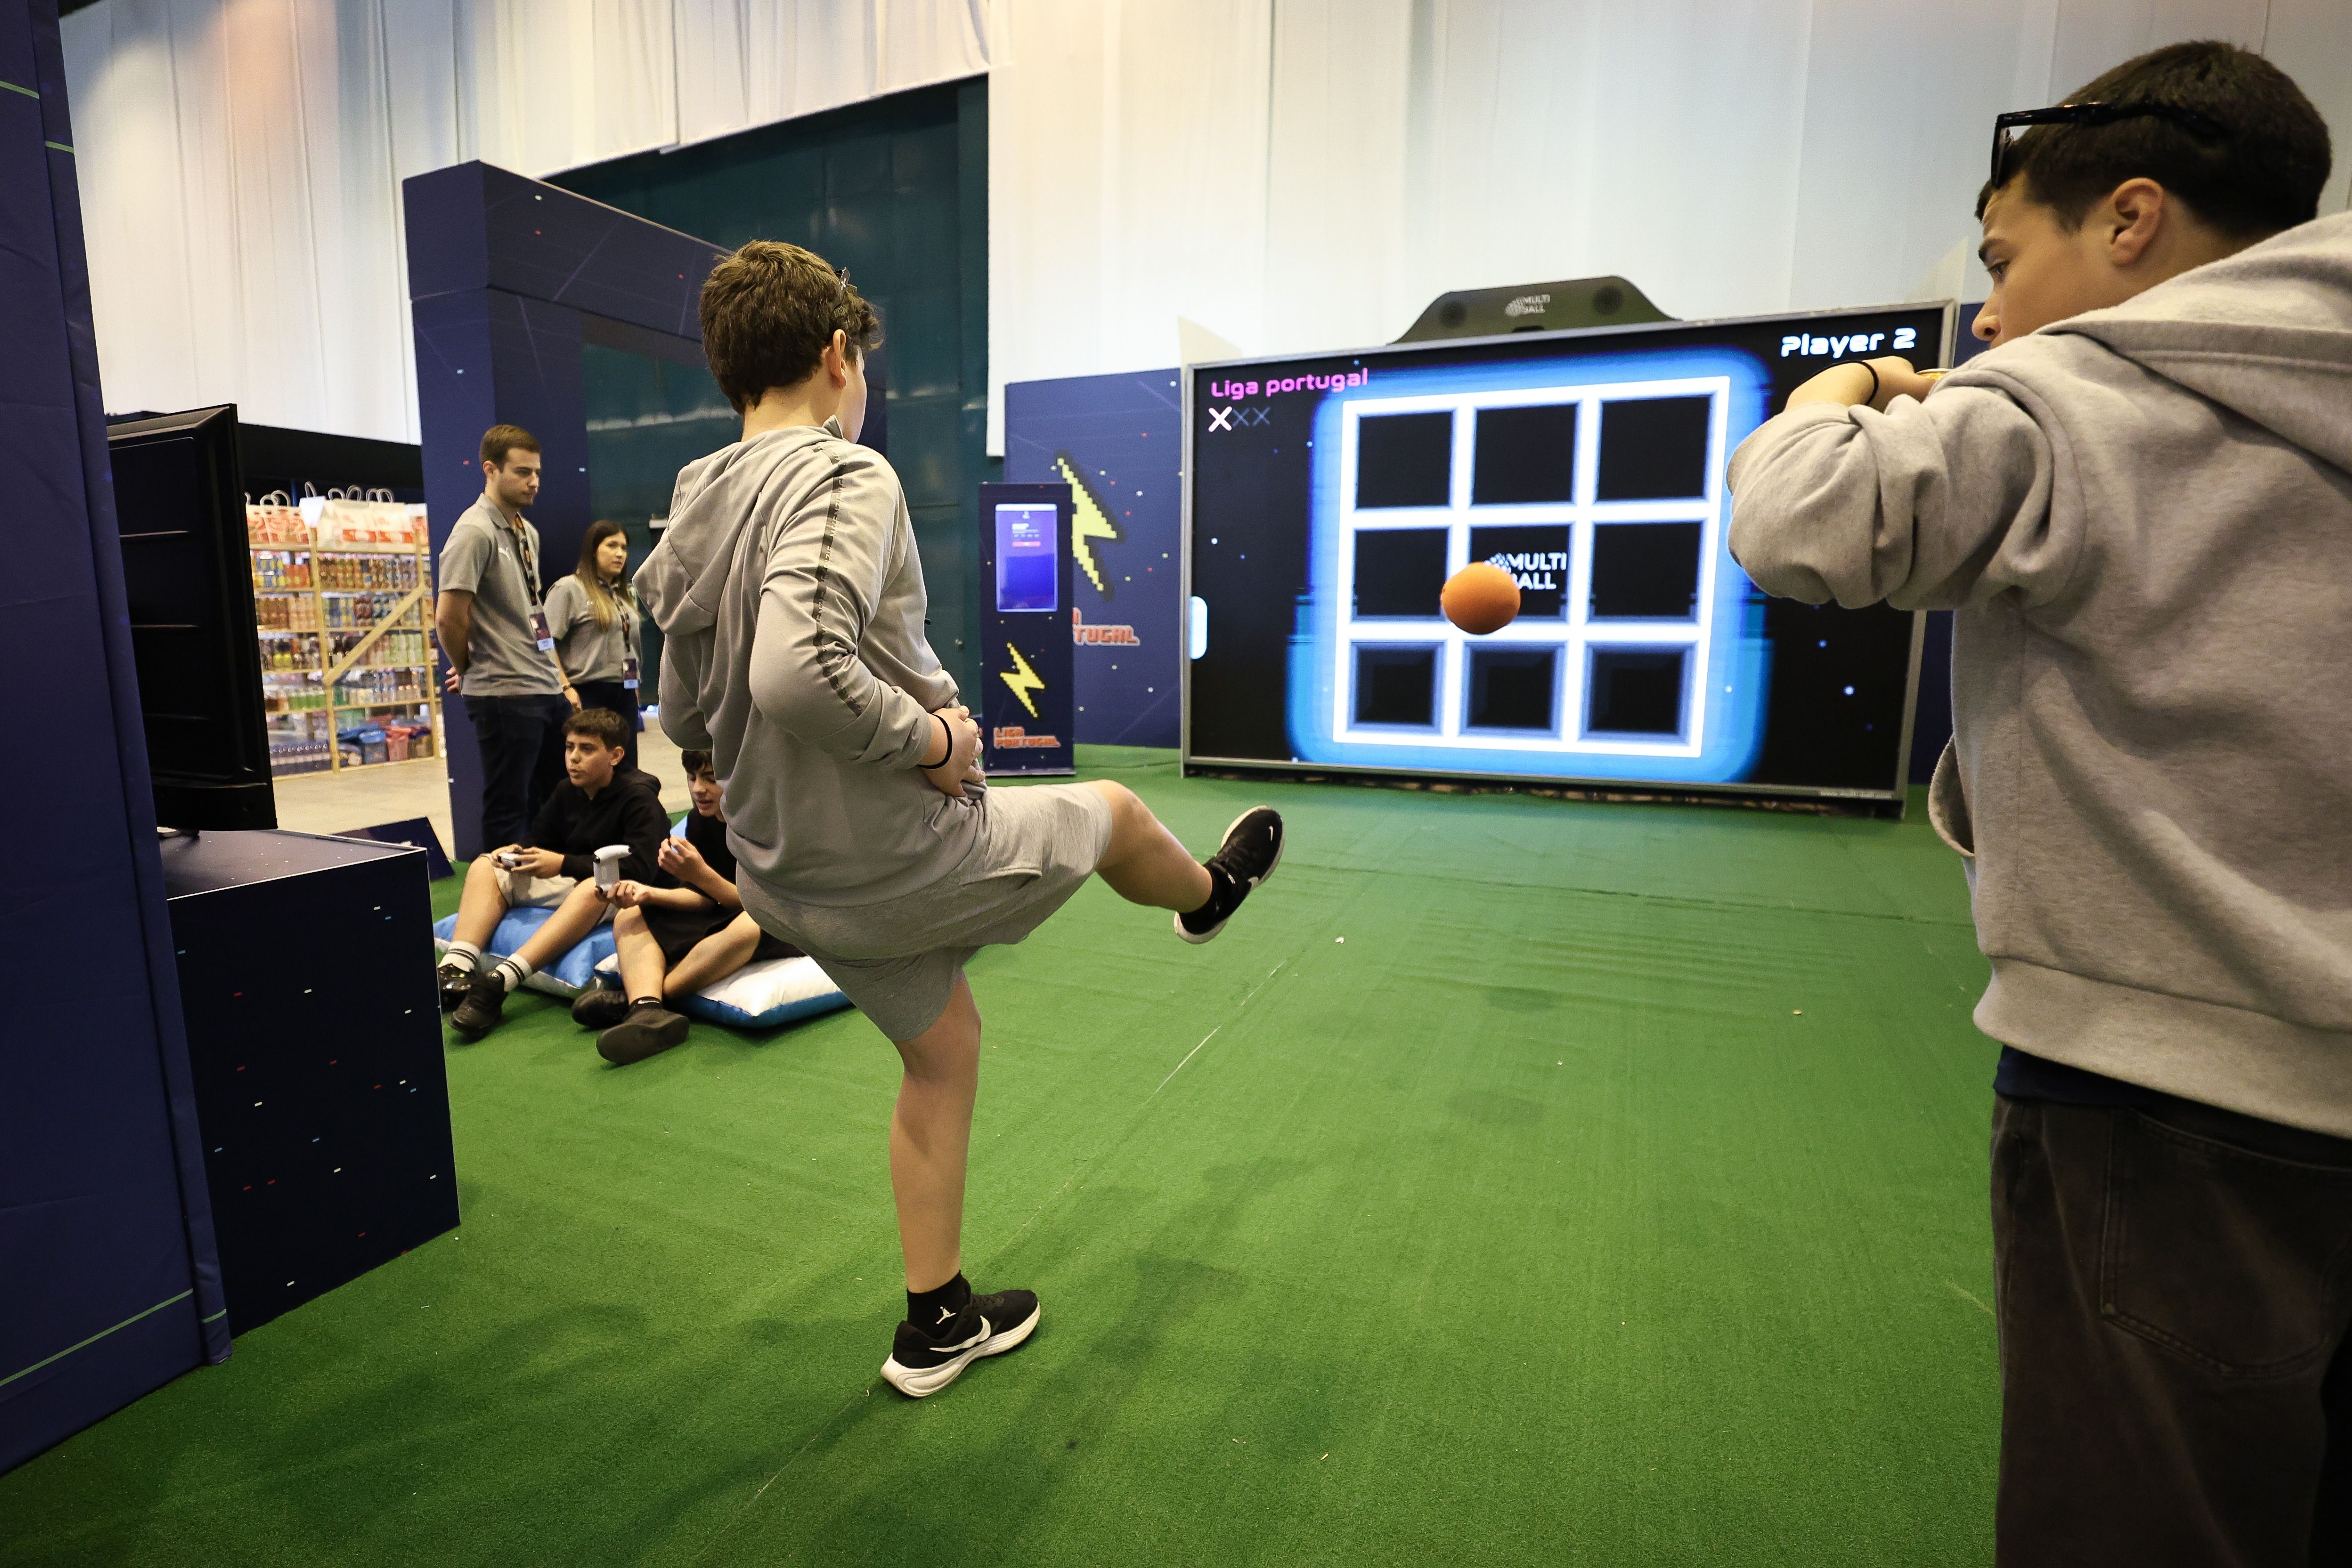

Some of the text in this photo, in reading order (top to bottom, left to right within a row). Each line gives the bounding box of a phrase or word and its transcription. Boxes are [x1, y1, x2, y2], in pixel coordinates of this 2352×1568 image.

[1781, 327, 1917, 358] Player 2
[1211, 367, 1368, 401] Liga portugal
[1506, 552, 1567, 571] MULTI
[1074, 626, 1139, 645] TUGAL
